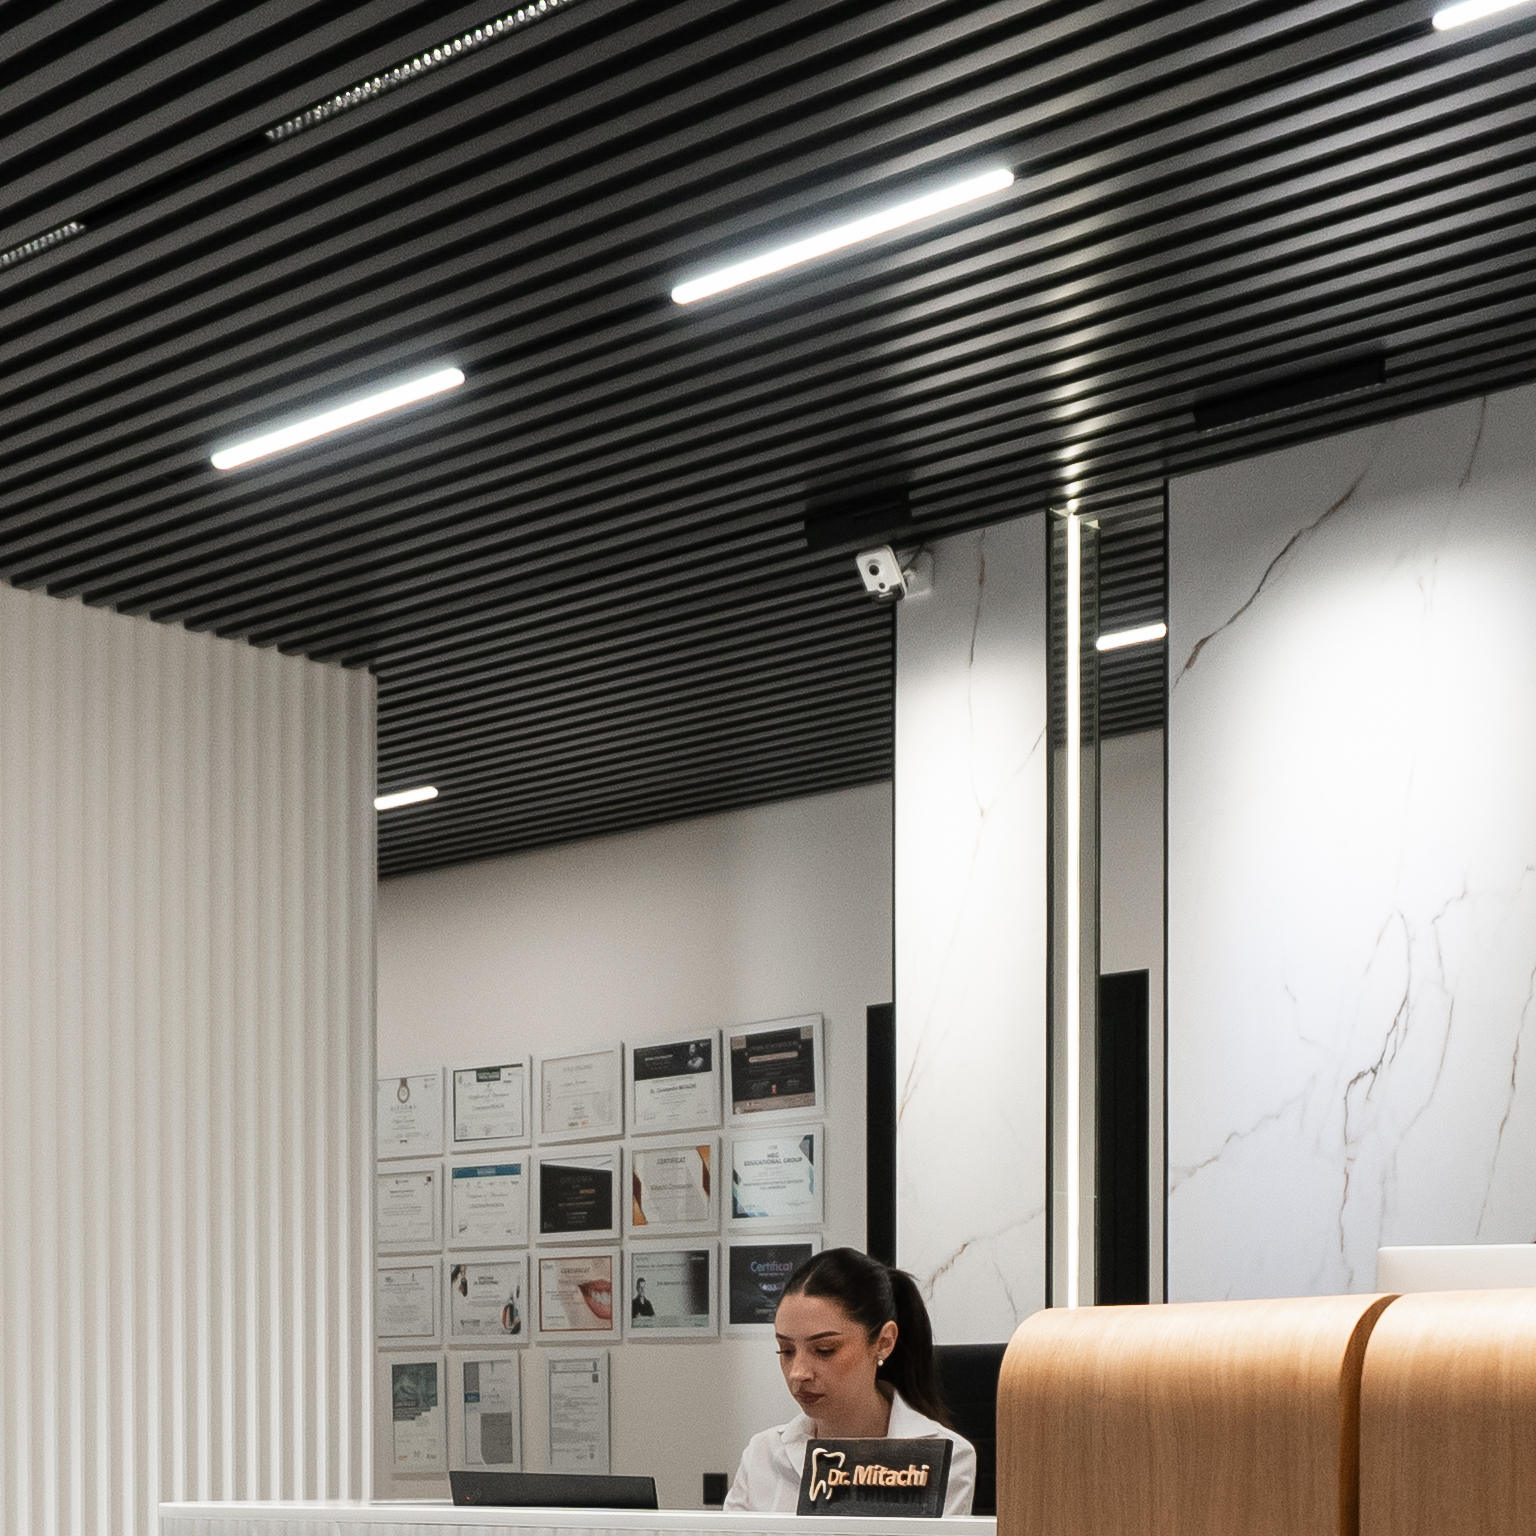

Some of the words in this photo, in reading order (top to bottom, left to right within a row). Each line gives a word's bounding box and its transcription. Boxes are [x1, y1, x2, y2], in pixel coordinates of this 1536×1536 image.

[750, 1261, 793, 1272] Certificat
[827, 1468, 850, 1486] Dr.
[853, 1464, 929, 1487] Mitachi
